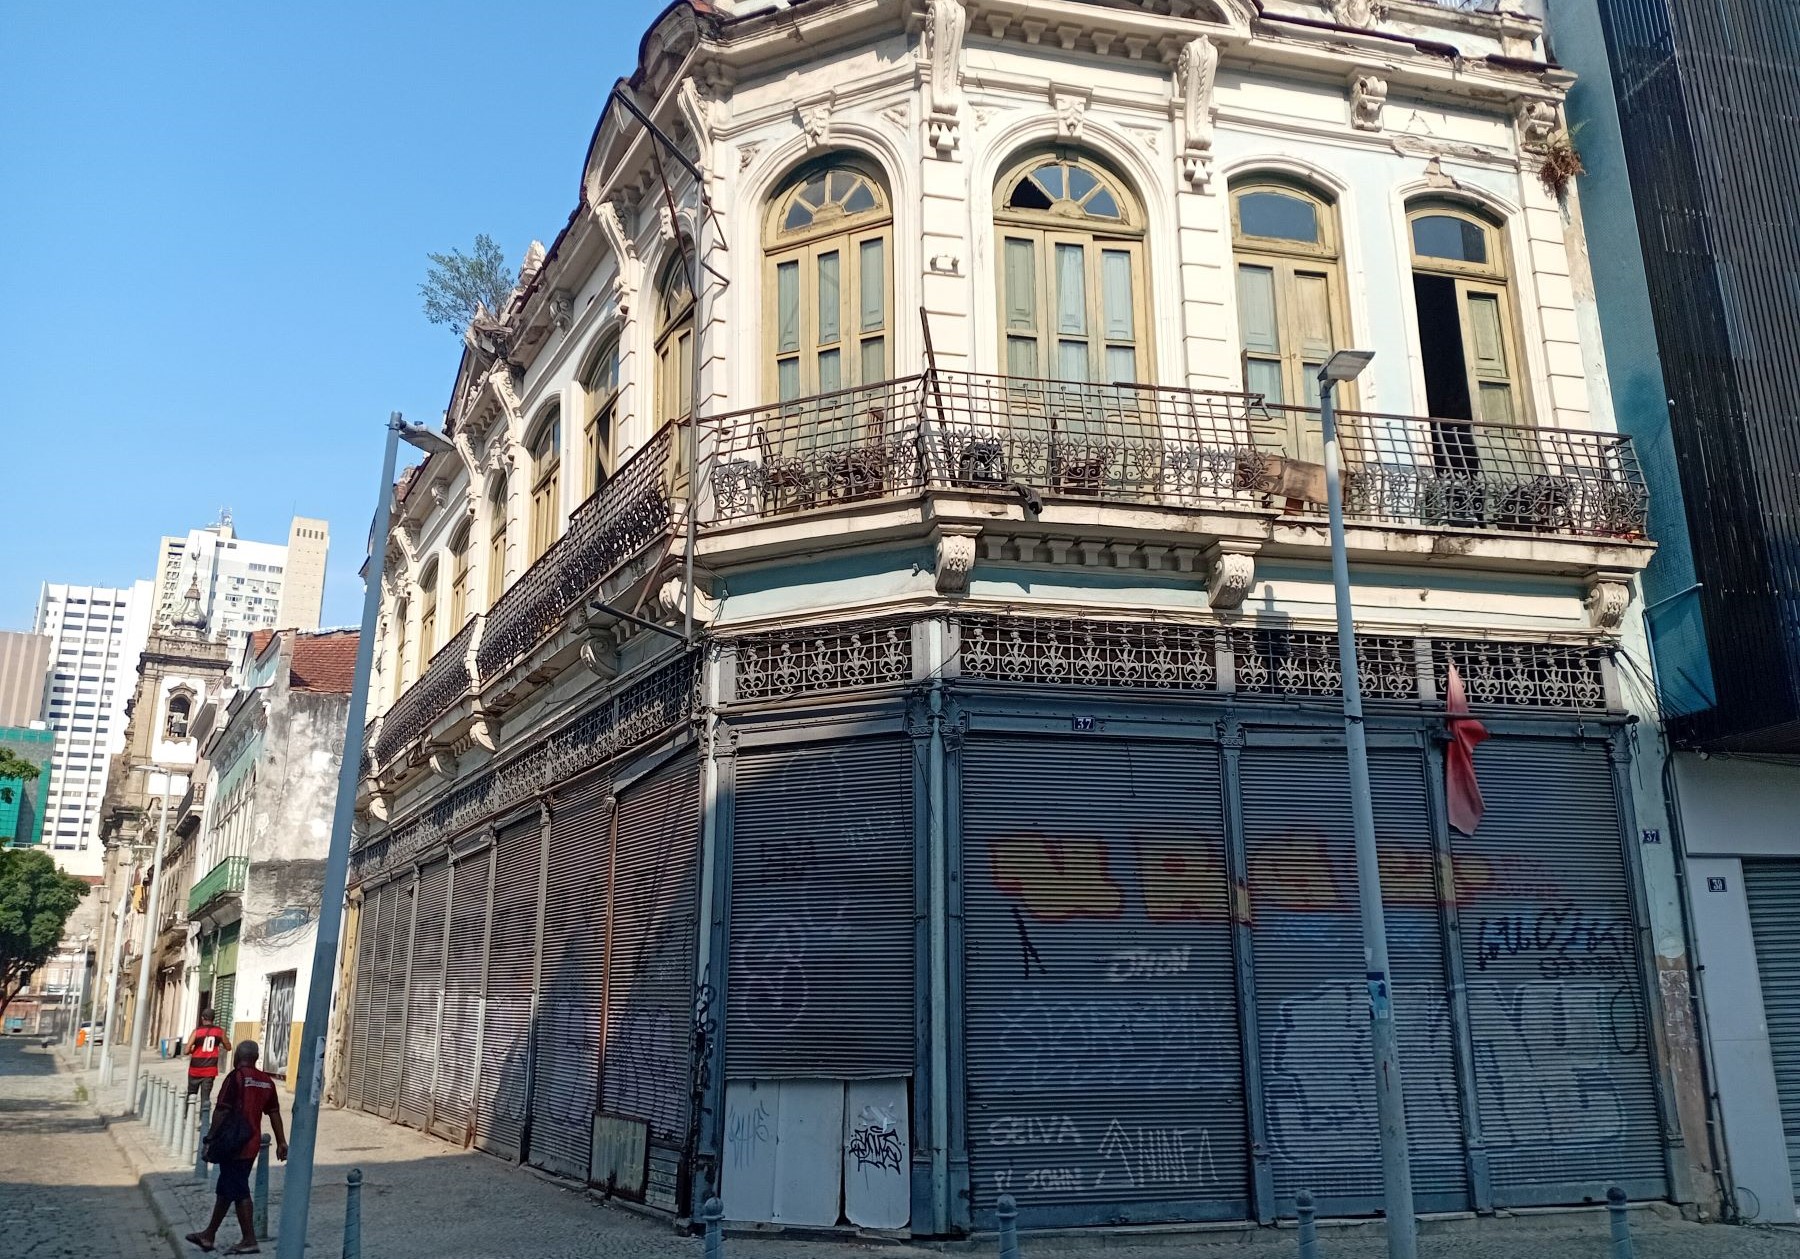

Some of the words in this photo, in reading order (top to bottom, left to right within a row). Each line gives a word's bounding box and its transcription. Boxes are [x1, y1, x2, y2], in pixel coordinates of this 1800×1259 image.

[1077, 718, 1092, 730] 37
[202, 1035, 216, 1053] 10
[989, 1116, 1083, 1147] SELVA
[1025, 1168, 1083, 1192] JOHN
